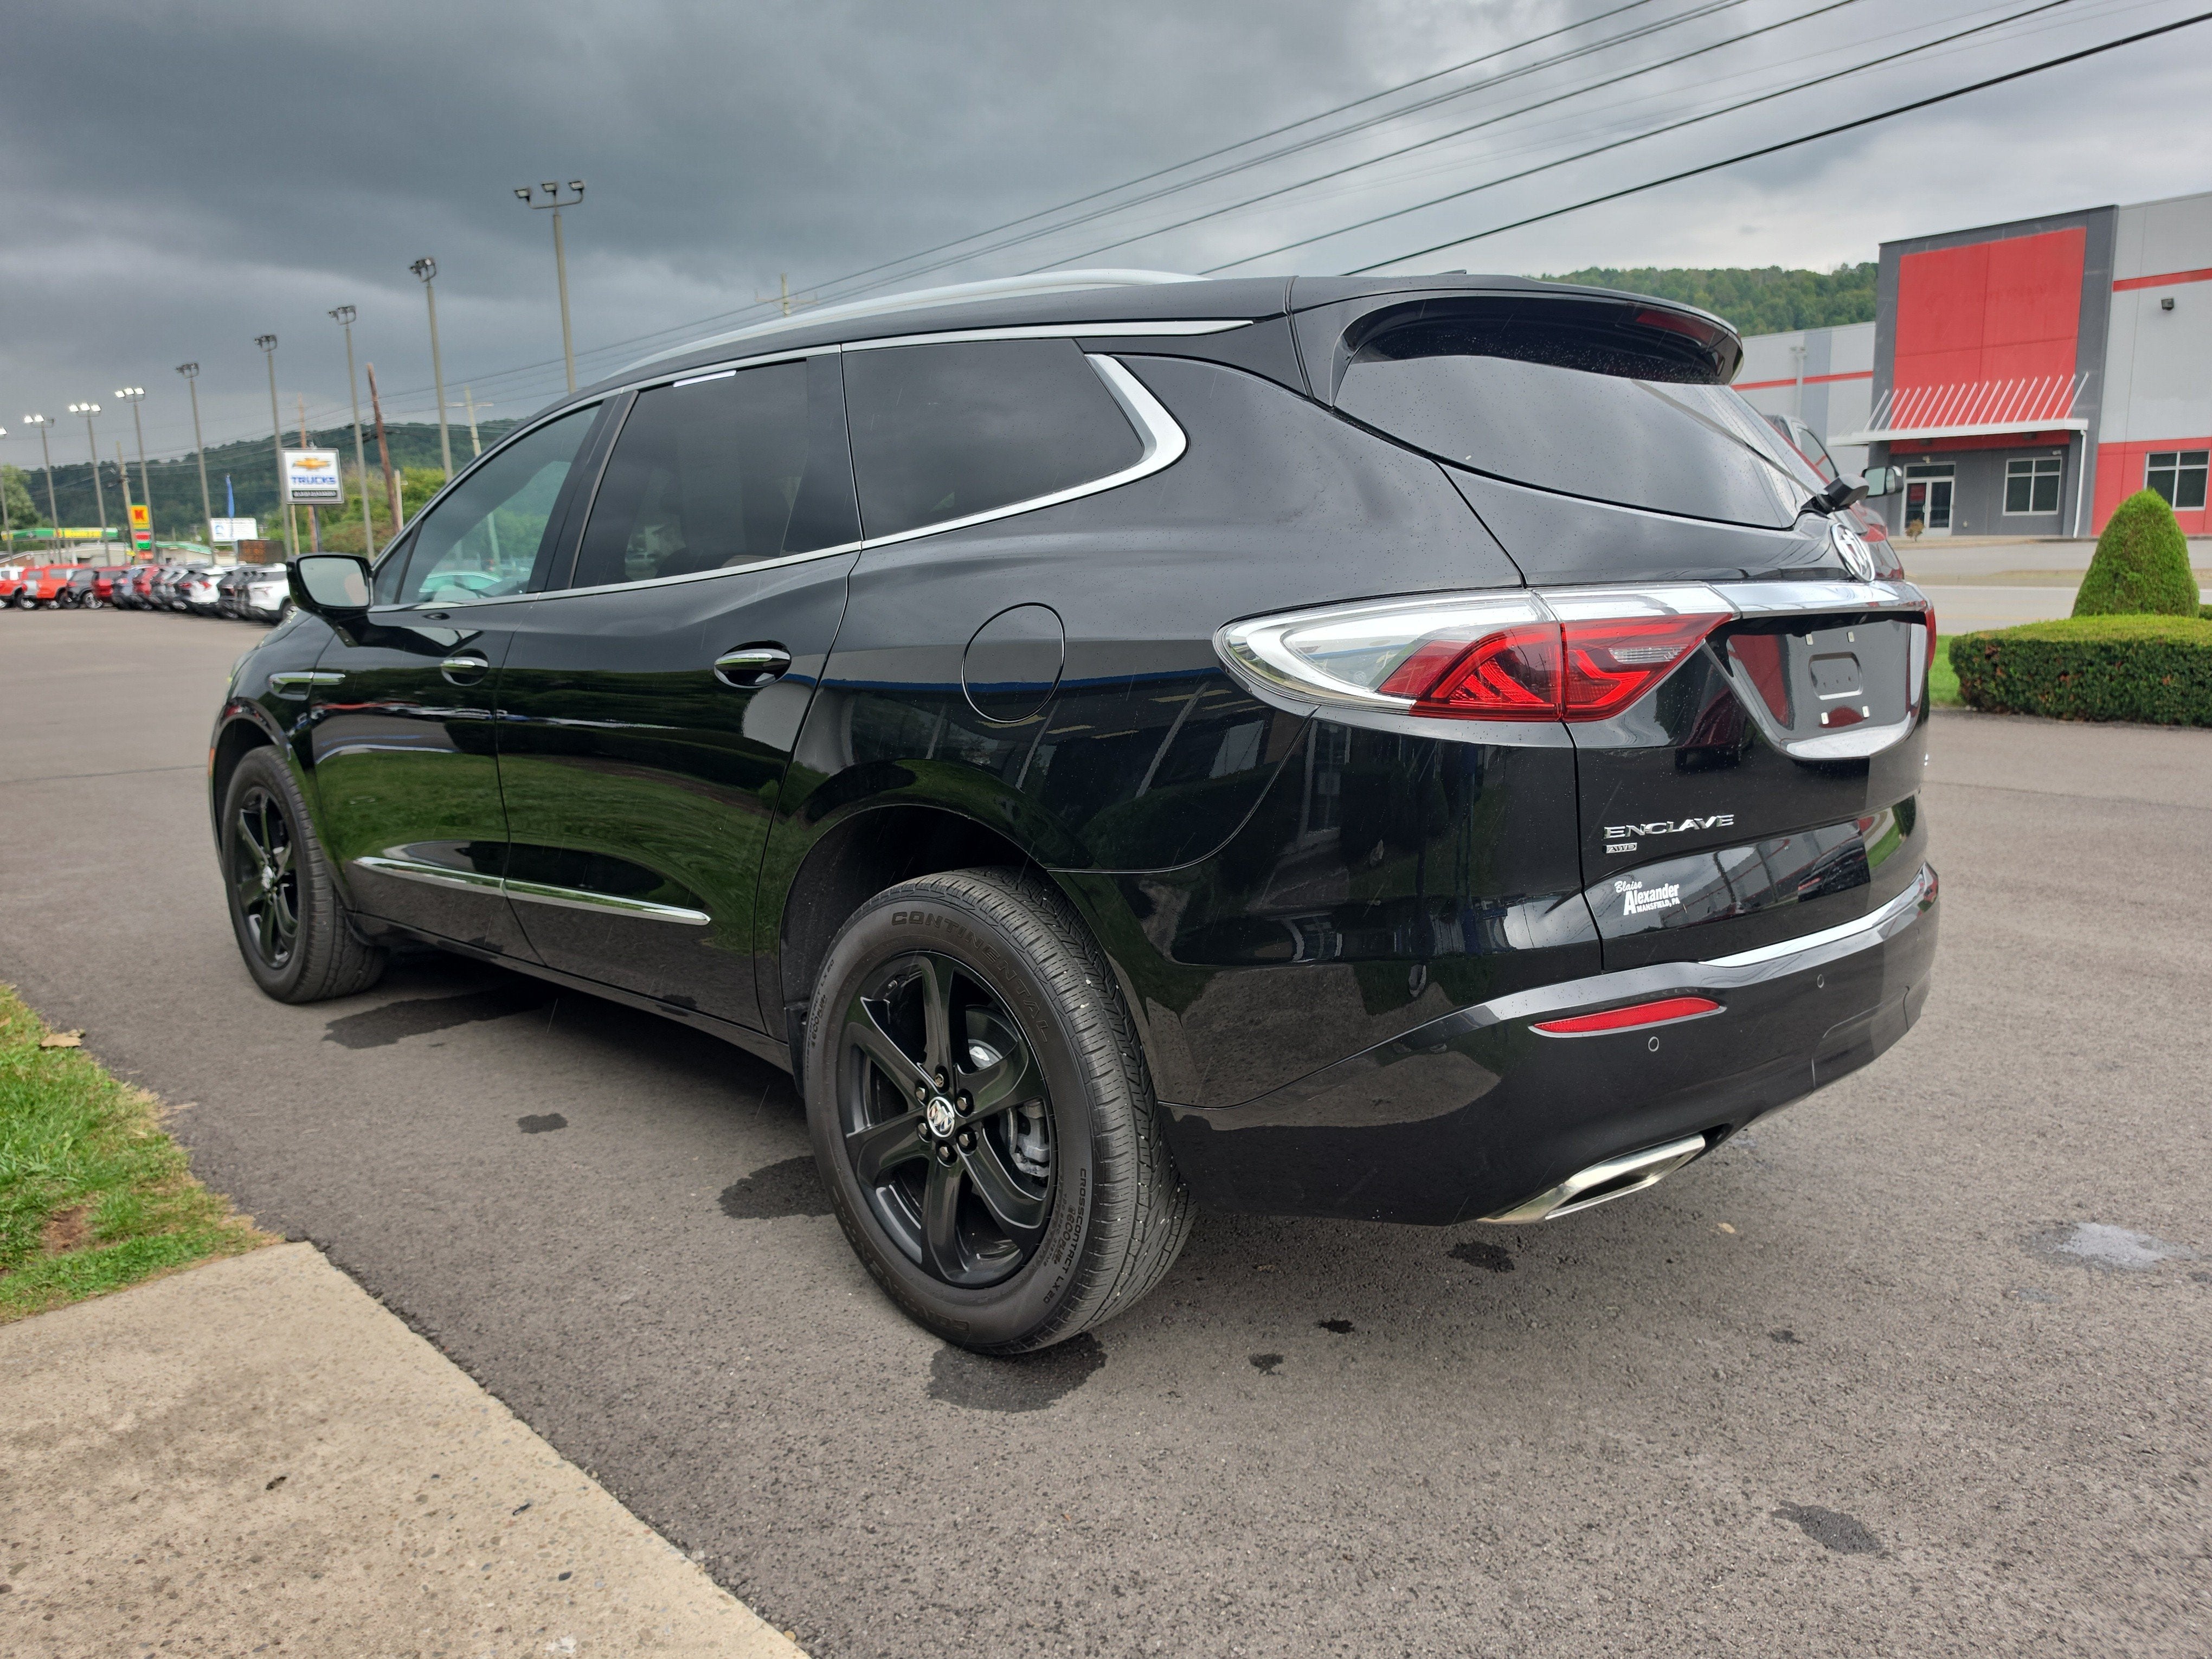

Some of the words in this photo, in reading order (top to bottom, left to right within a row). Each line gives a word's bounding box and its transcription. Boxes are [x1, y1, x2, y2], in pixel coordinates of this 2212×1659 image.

[291, 476, 336, 485] TRUCKS
[1604, 814, 1734, 839] ENCLAVE
[1607, 843, 1637, 853] AWD
[1614, 880, 1642, 893] Blaise
[1623, 883, 1680, 916] Alexander
[1636, 899, 1673, 913] MANSFIELD,
[1671, 897, 1681, 906] PA
[891, 911, 1049, 1043] CONTINENTAL
[1062, 1168, 1086, 1274] CROSSCONTACT
